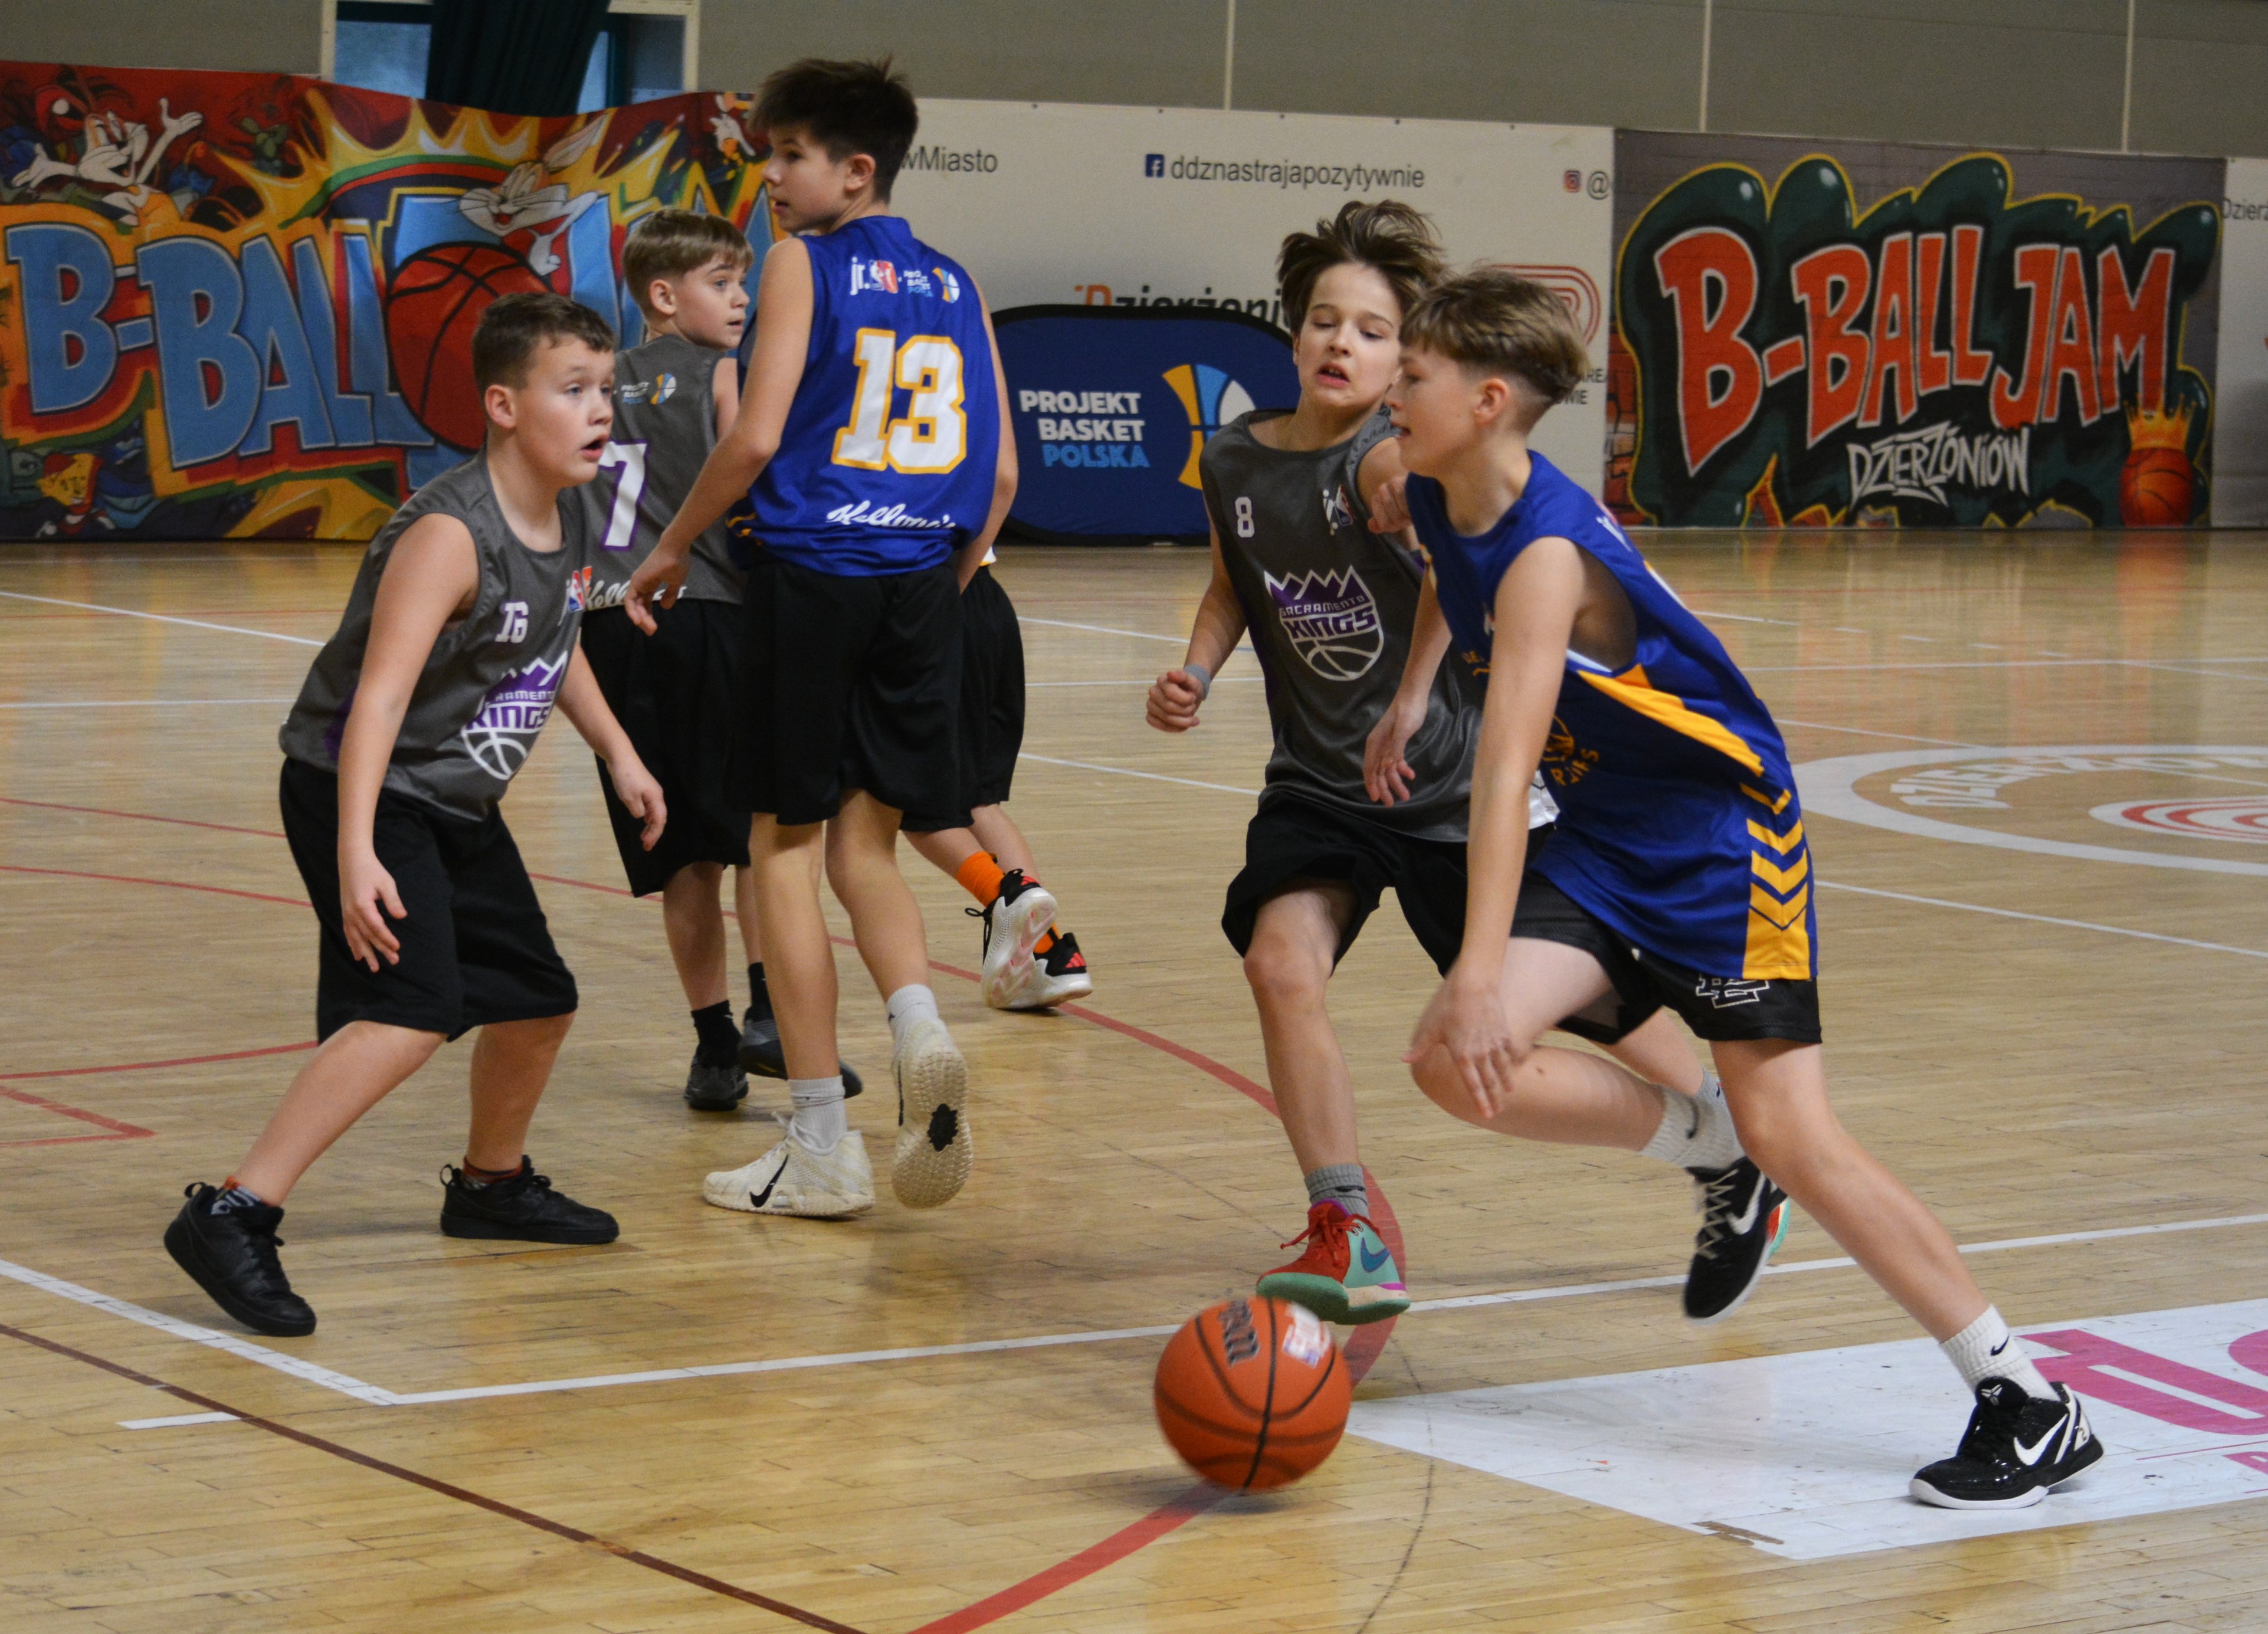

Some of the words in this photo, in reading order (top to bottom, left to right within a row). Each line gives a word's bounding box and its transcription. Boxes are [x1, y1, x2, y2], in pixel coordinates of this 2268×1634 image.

[901, 146, 998, 172] wMiasto
[1171, 156, 1425, 192] ddznastrajapozytywnie
[5, 223, 434, 470] B-BALL
[1654, 226, 1994, 477] B-BALL
[1990, 244, 2176, 429] JAM
[831, 327, 968, 474] 13
[1019, 390, 1141, 414] PROJEKT
[1038, 418, 1145, 442] BASKET
[1043, 444, 1151, 468] POLSKA
[598, 438, 650, 552] 7
[1235, 497, 1256, 538] 8
[1279, 595, 1365, 617] SACRAMENTO
[1283, 603, 1377, 640] KINGS
